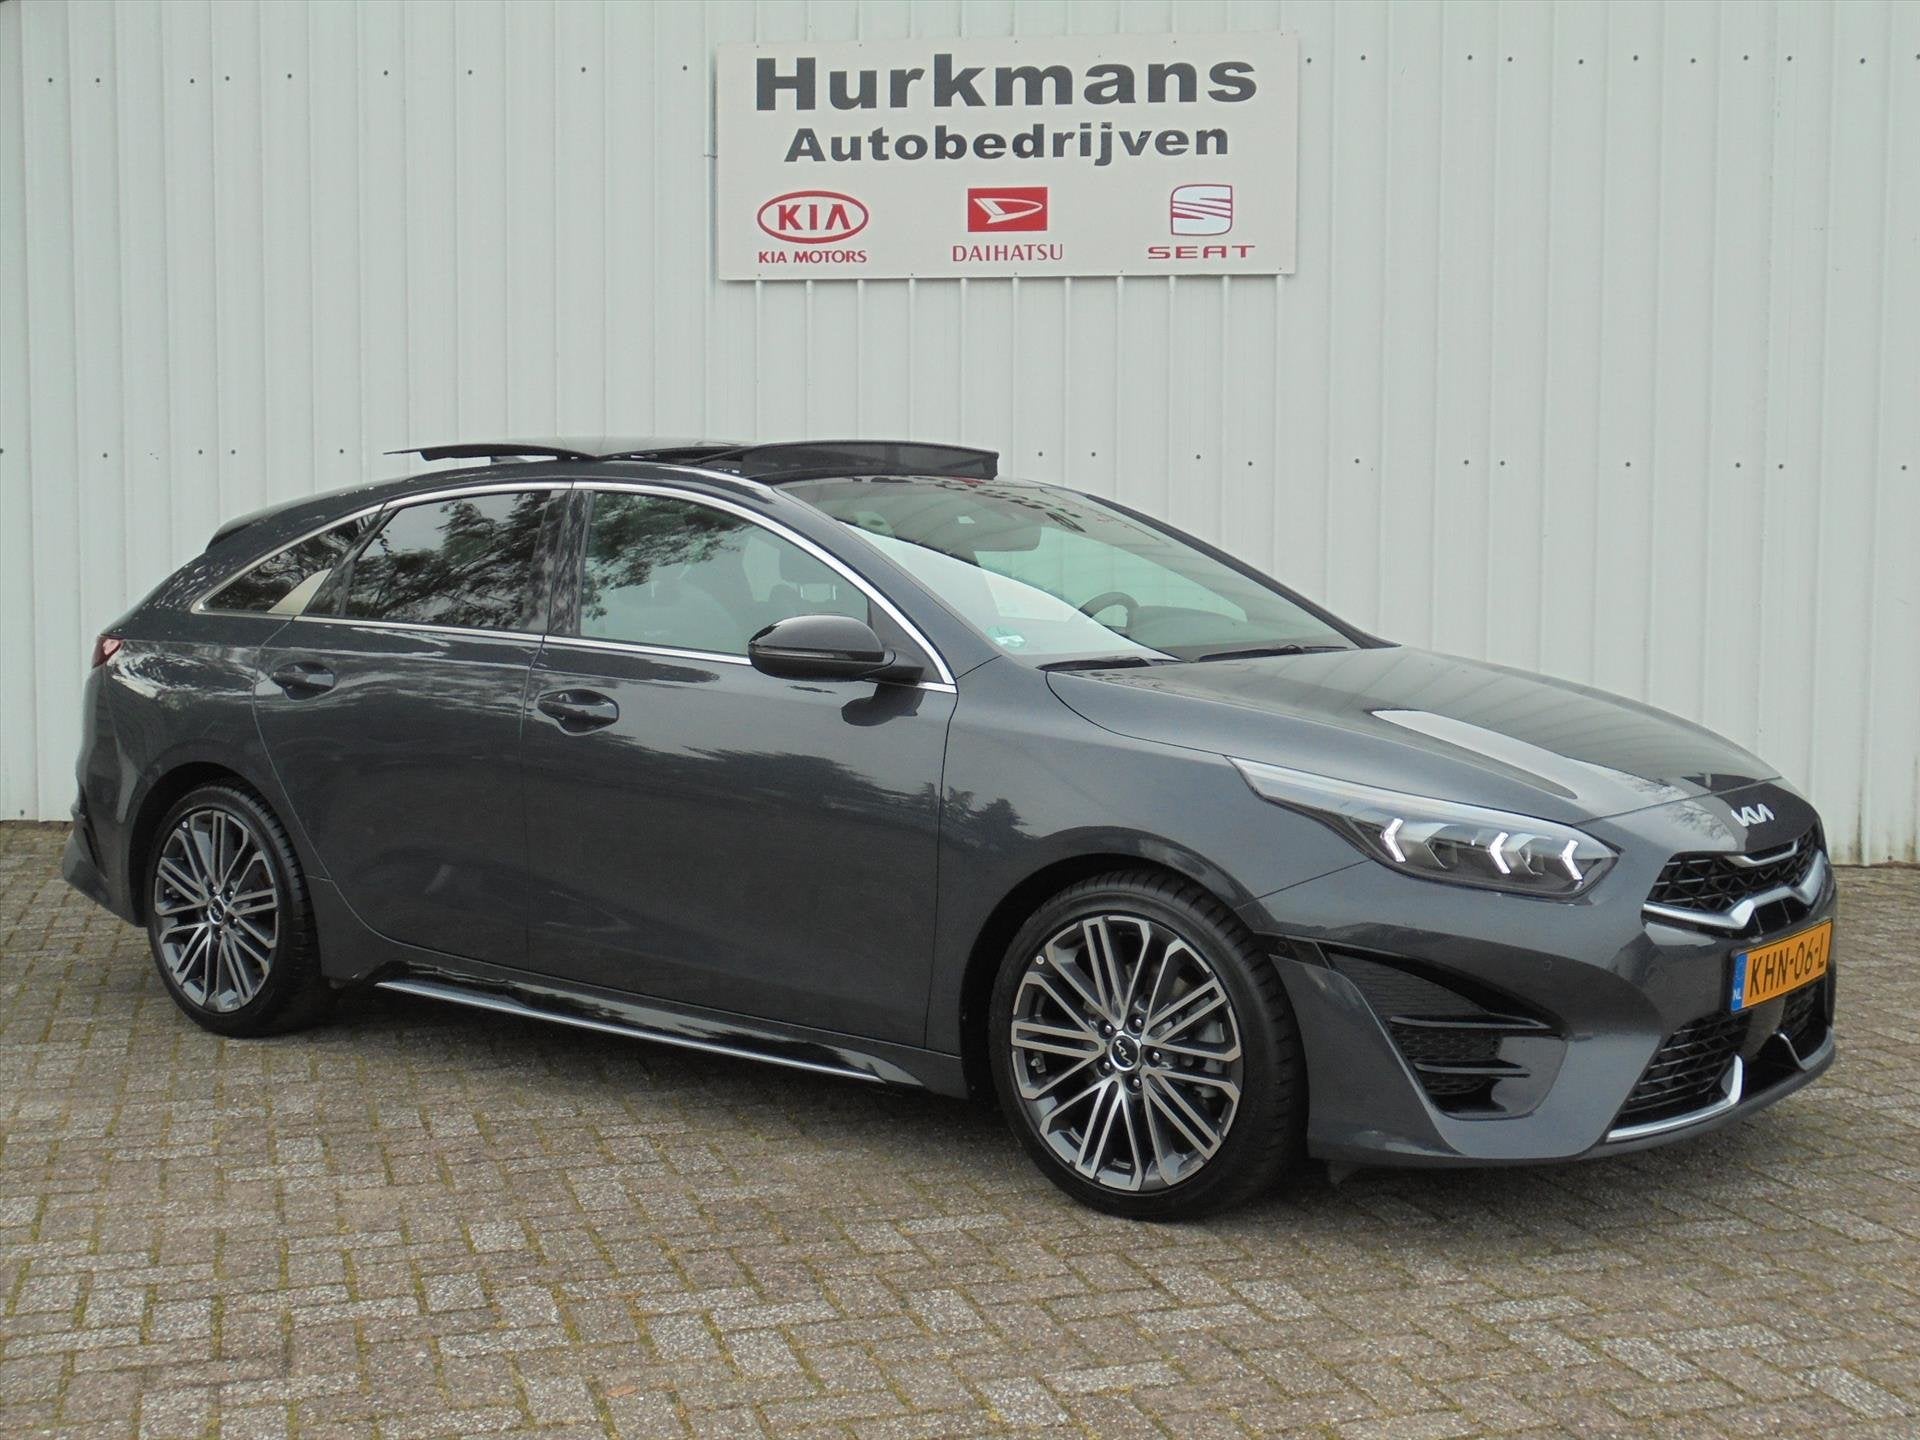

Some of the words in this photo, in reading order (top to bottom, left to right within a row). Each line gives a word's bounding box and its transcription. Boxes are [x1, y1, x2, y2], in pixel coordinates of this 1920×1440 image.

[755, 53, 1257, 111] Hurkmans
[784, 122, 1229, 167] Autobedrijven
[777, 204, 852, 232] KIA
[758, 251, 790, 264] KIA
[793, 249, 868, 264] MOTORS
[952, 244, 1064, 262] DAIHATSU
[1147, 245, 1256, 260] SEAT
[1749, 932, 1825, 998] KHN-06-L
